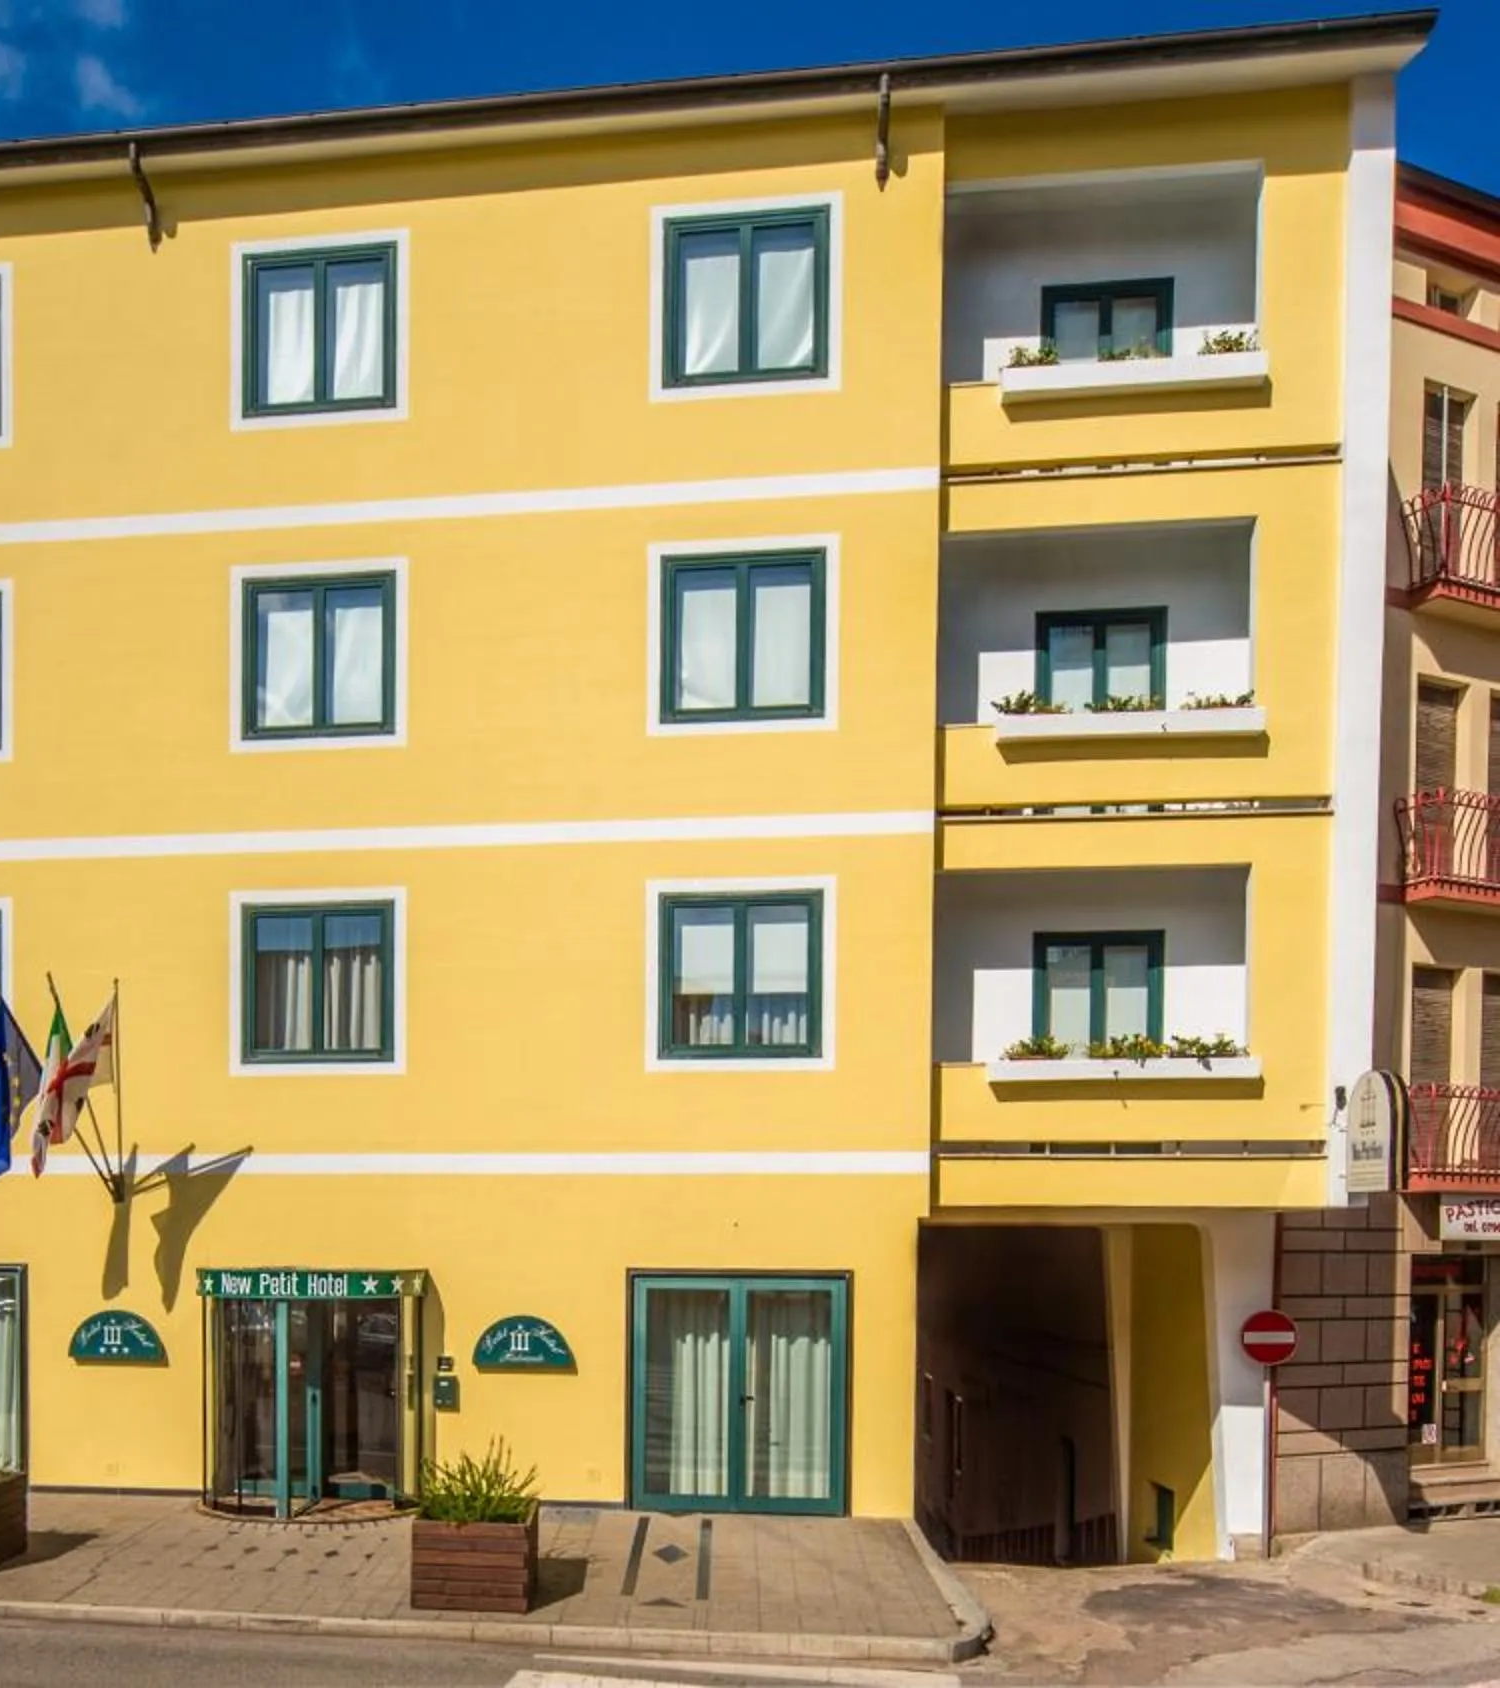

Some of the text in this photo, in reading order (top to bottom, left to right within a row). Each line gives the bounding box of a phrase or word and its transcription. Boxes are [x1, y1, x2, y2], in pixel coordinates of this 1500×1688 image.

[221, 1273, 347, 1296] New Petit Hotel
